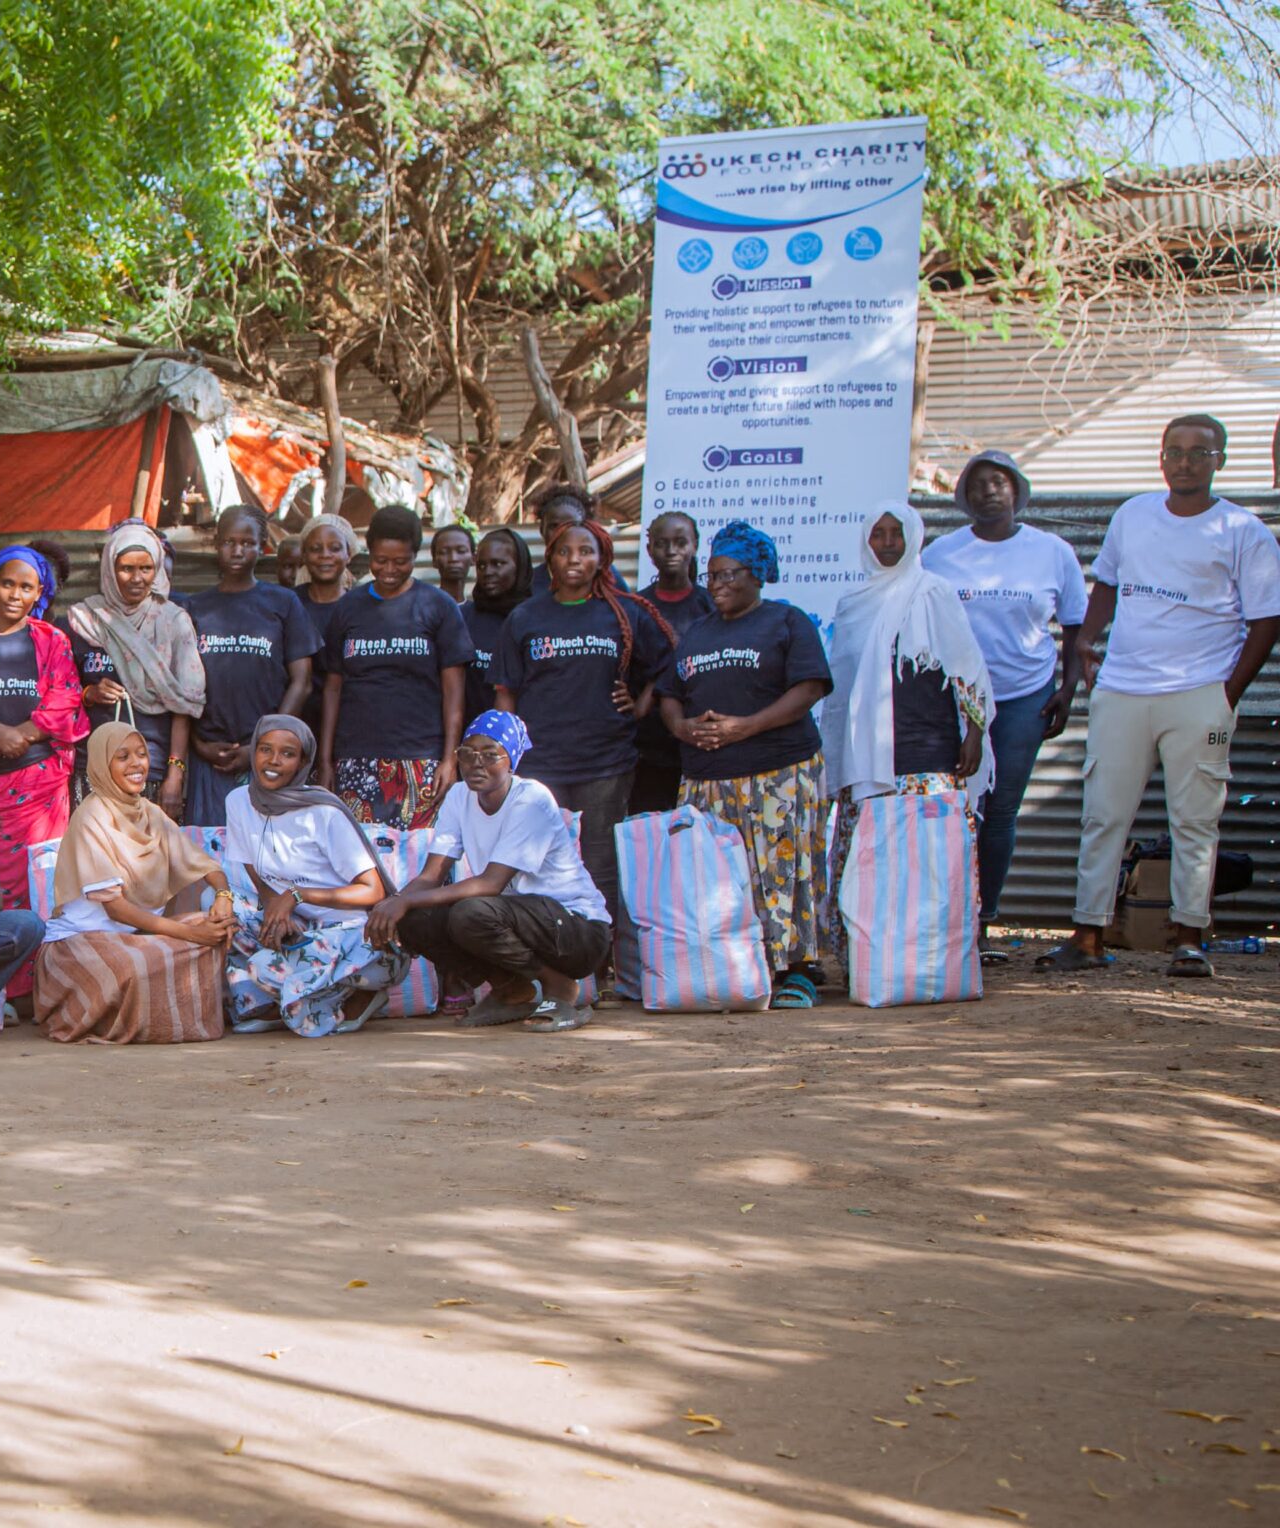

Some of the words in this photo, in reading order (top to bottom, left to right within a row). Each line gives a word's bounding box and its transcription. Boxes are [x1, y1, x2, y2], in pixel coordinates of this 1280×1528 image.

[711, 150, 801, 168] UKECH
[815, 141, 925, 159] CHARITY
[720, 155, 908, 176] FOUNDATION
[760, 184, 786, 194] rise
[790, 182, 805, 194] by
[810, 176, 850, 191] lifting
[855, 176, 893, 188] other
[744, 278, 801, 292] Mission
[664, 307, 709, 321] Providing
[713, 304, 749, 317] holistic
[753, 302, 791, 316] support
[794, 303, 805, 312] to
[808, 300, 852, 312] refugees
[855, 299, 867, 309] to
[869, 299, 903, 308] nuture
[673, 324, 696, 335] their
[699, 321, 745, 334] wellbeing
[748, 320, 767, 330] and
[770, 318, 816, 330] empower
[819, 315, 846, 325] them
[849, 315, 860, 324] to
[863, 313, 893, 324] thrive
[708, 336, 746, 349] despite
[748, 334, 772, 345] their
[740, 361, 798, 374] Vision
[665, 387, 726, 402] Empowering
[728, 387, 746, 398] and
[749, 385, 778, 399] giving
[782, 384, 820, 397] support
[823, 383, 834, 393] to
[837, 381, 882, 393] refugees
[885, 382, 897, 392] to
[667, 405, 699, 415] create
[710, 402, 749, 416] brighter
[752, 400, 783, 412] future
[785, 398, 811, 410] filled
[814, 398, 836, 409] with
[838, 397, 871, 410] hopes
[874, 397, 893, 407] and
[740, 451, 794, 464] Goals
[673, 477, 740, 490] Education
[746, 475, 823, 487] enrichment
[672, 498, 715, 508] Health
[722, 497, 745, 507] and
[751, 495, 817, 508] wellbeing
[771, 514, 795, 525] and
[795, 571, 865, 583] networkin
[207, 635, 236, 646] Ukech
[238, 634, 272, 651] Charity
[355, 638, 387, 649] Ukech
[391, 636, 428, 649] Charity
[552, 636, 583, 649] Ukech
[586, 635, 617, 652] Charity
[207, 645, 272, 657] FOUNDATION
[354, 647, 430, 656] FOUNDATION
[553, 647, 618, 658] FOUNDATION
[692, 650, 720, 666] Ukech
[722, 648, 760, 662] Charity
[693, 659, 760, 675] FOUNDATION
[1208, 731, 1228, 746] BIG
